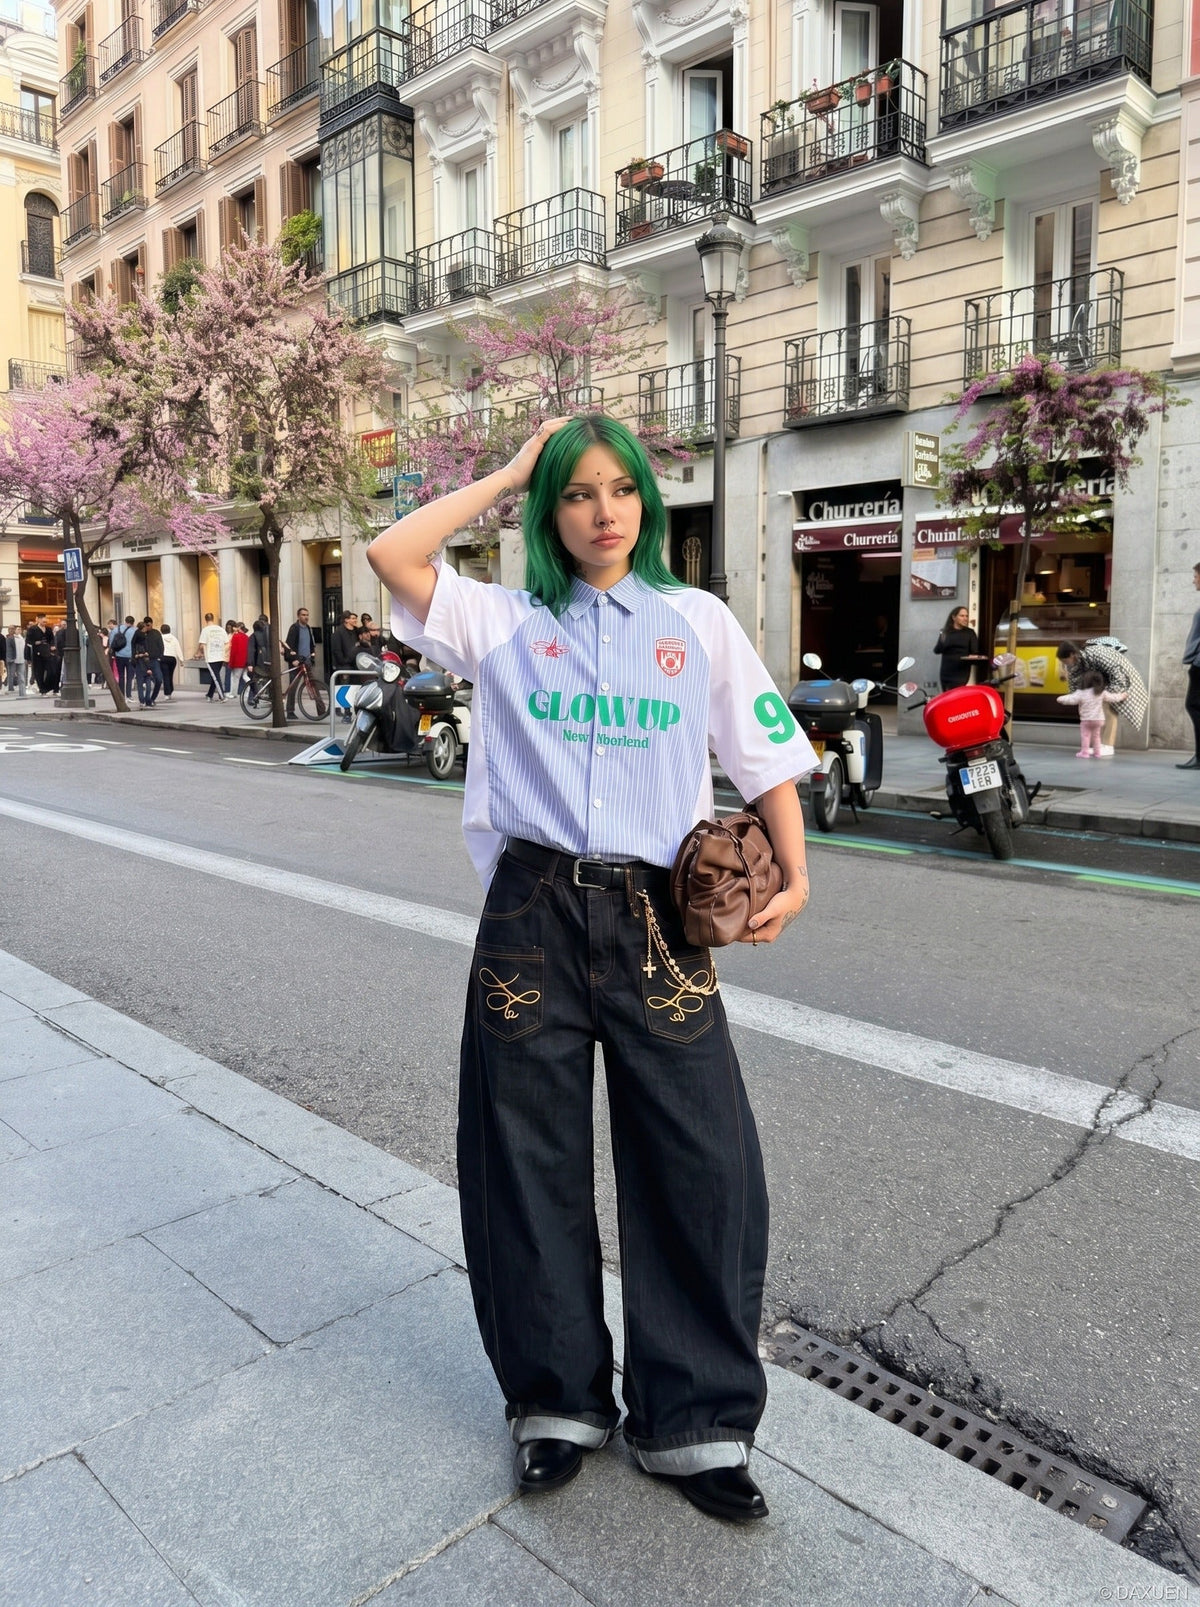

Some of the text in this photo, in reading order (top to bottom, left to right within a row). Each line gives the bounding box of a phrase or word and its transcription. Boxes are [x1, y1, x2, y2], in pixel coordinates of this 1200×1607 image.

[809, 491, 901, 522] Churrería
[843, 530, 898, 547] Churrería
[528, 689, 681, 732] GLOW UP
[753, 691, 796, 745] 9
[563, 729, 590, 743] New
[968, 763, 996, 778] 7223
